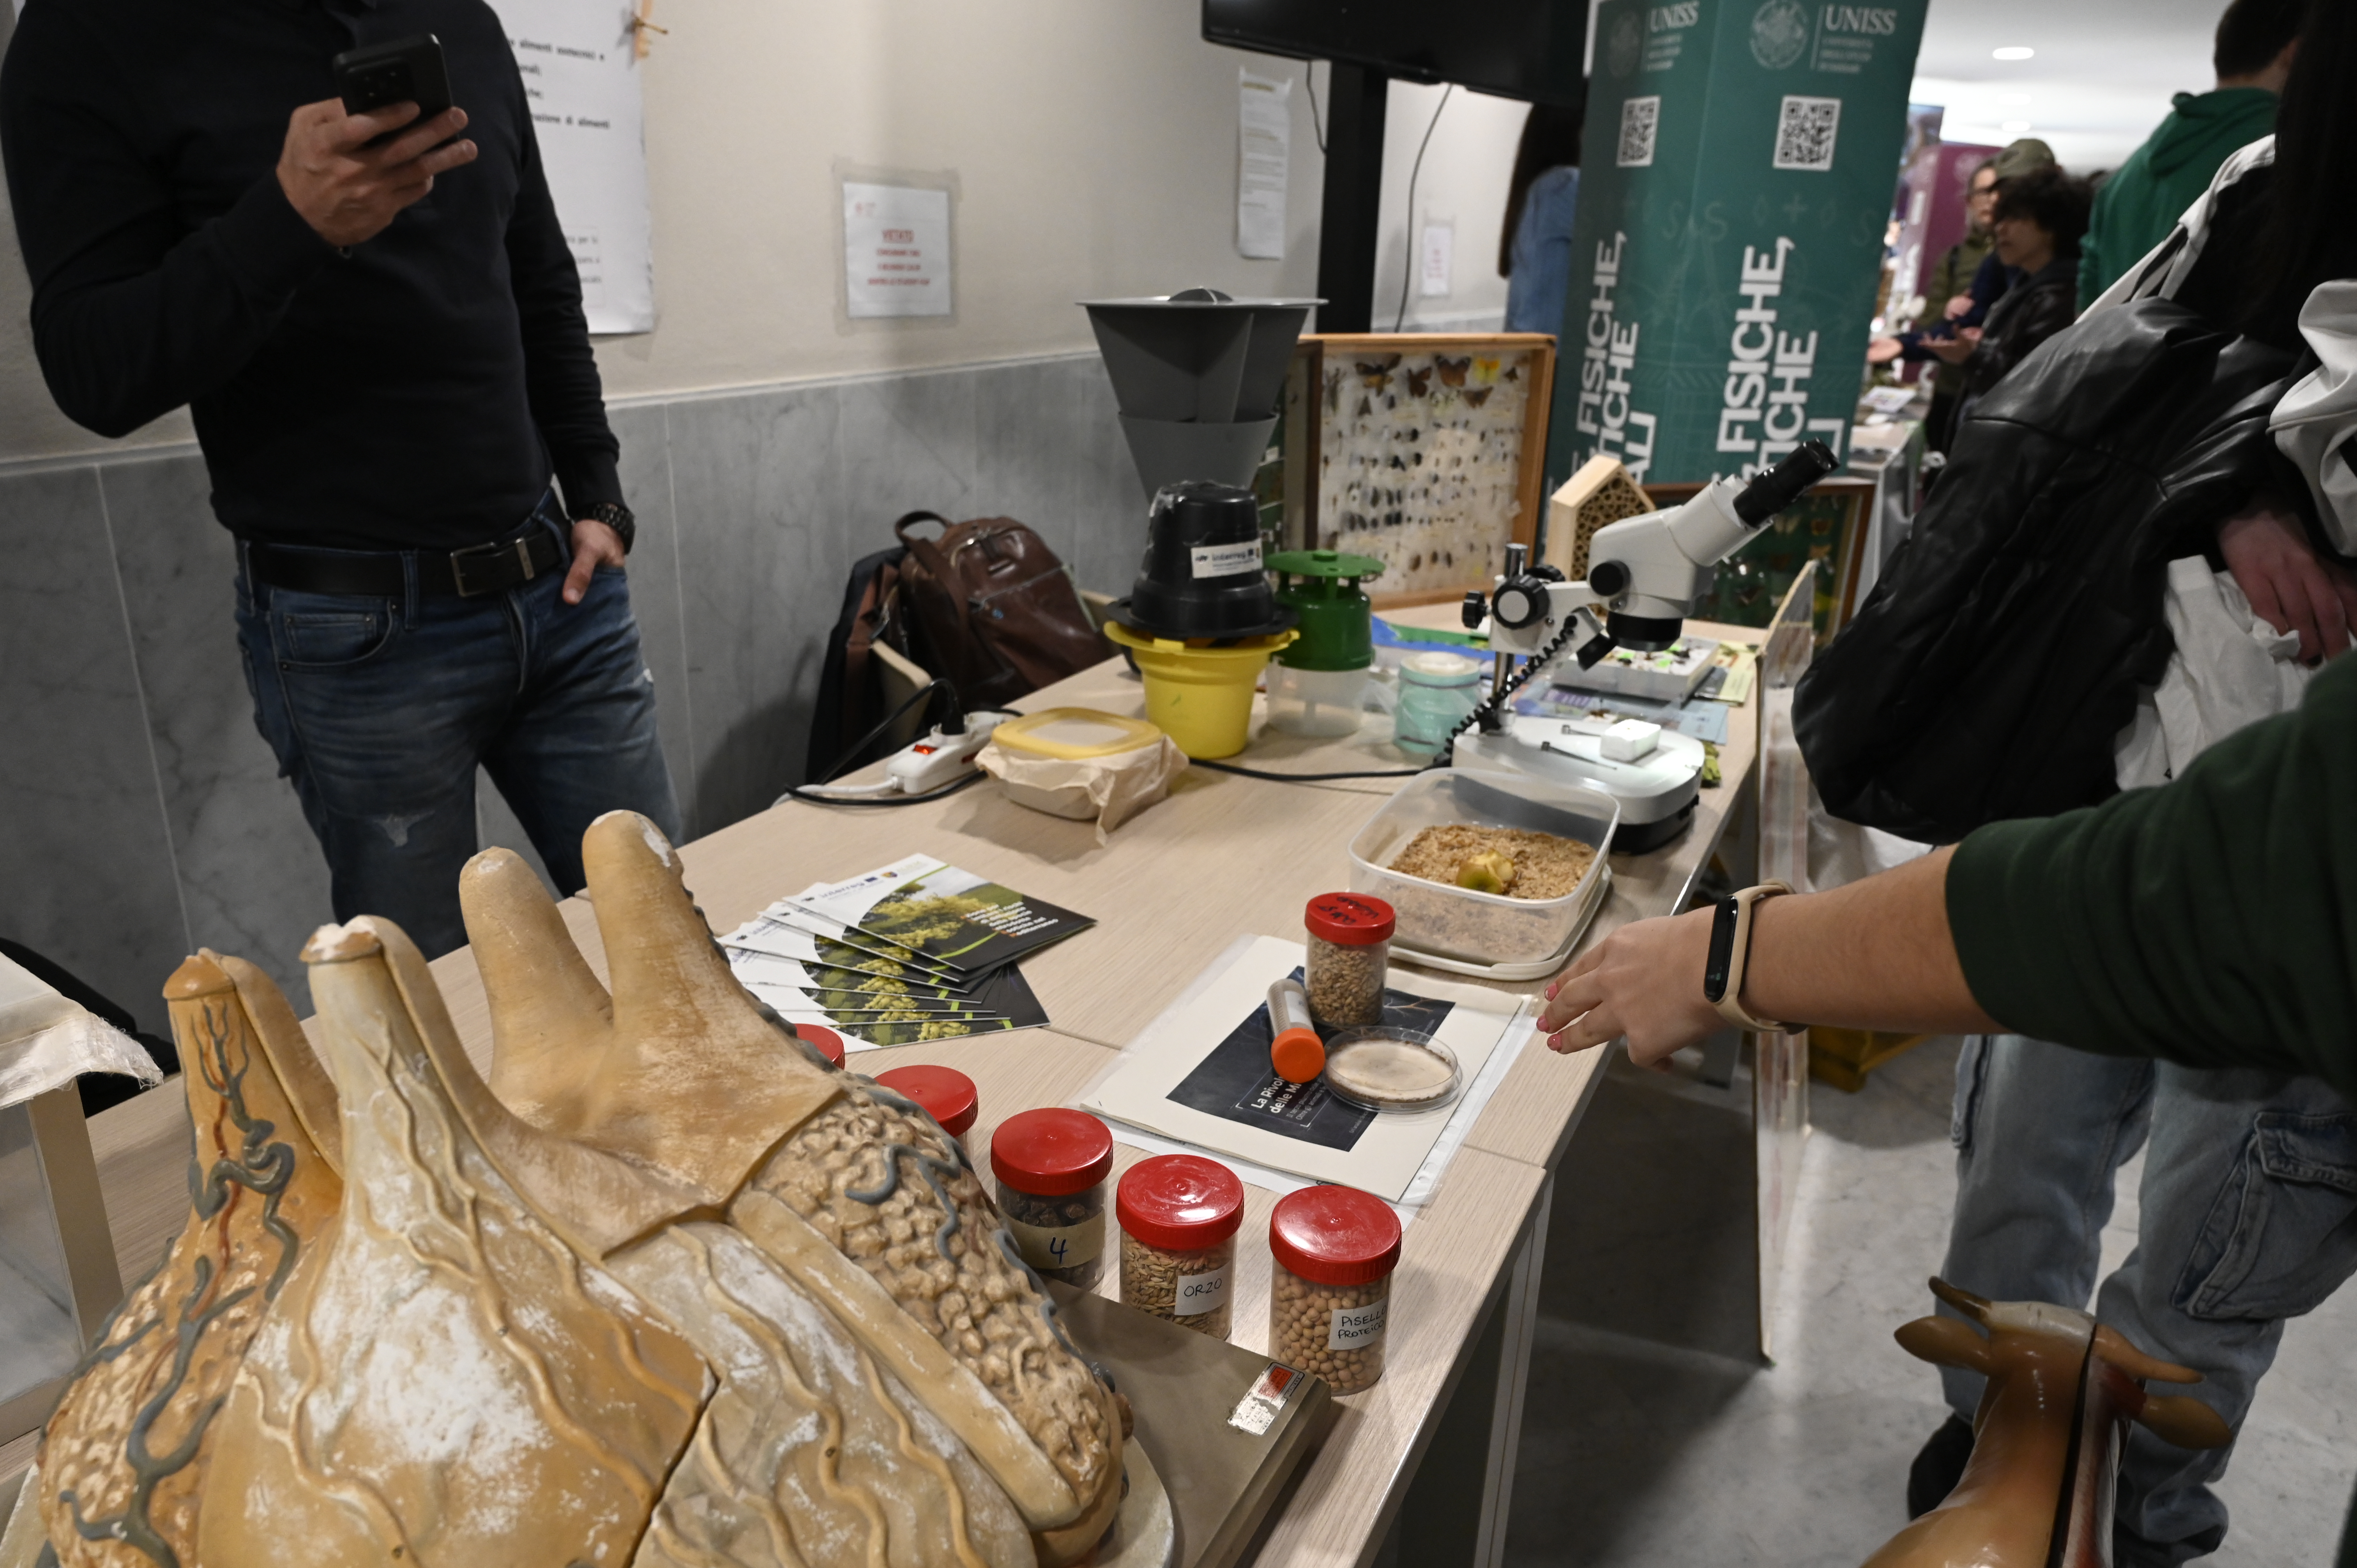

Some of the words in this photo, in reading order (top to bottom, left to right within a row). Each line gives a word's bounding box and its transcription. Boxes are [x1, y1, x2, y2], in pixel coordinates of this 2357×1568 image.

[1825, 4, 1897, 35] UNISS
[1576, 230, 1627, 436] FISICHE,
[1716, 235, 1796, 452] FISICHE,
[1251, 1098, 1268, 1109] La
[1270, 1093, 1292, 1113] delle
[1285, 1083, 1302, 1093] Mi
[1050, 1237, 1069, 1264] 4
[1184, 1278, 1222, 1297] ORZO
[1341, 1305, 1387, 1327] PISELLO
